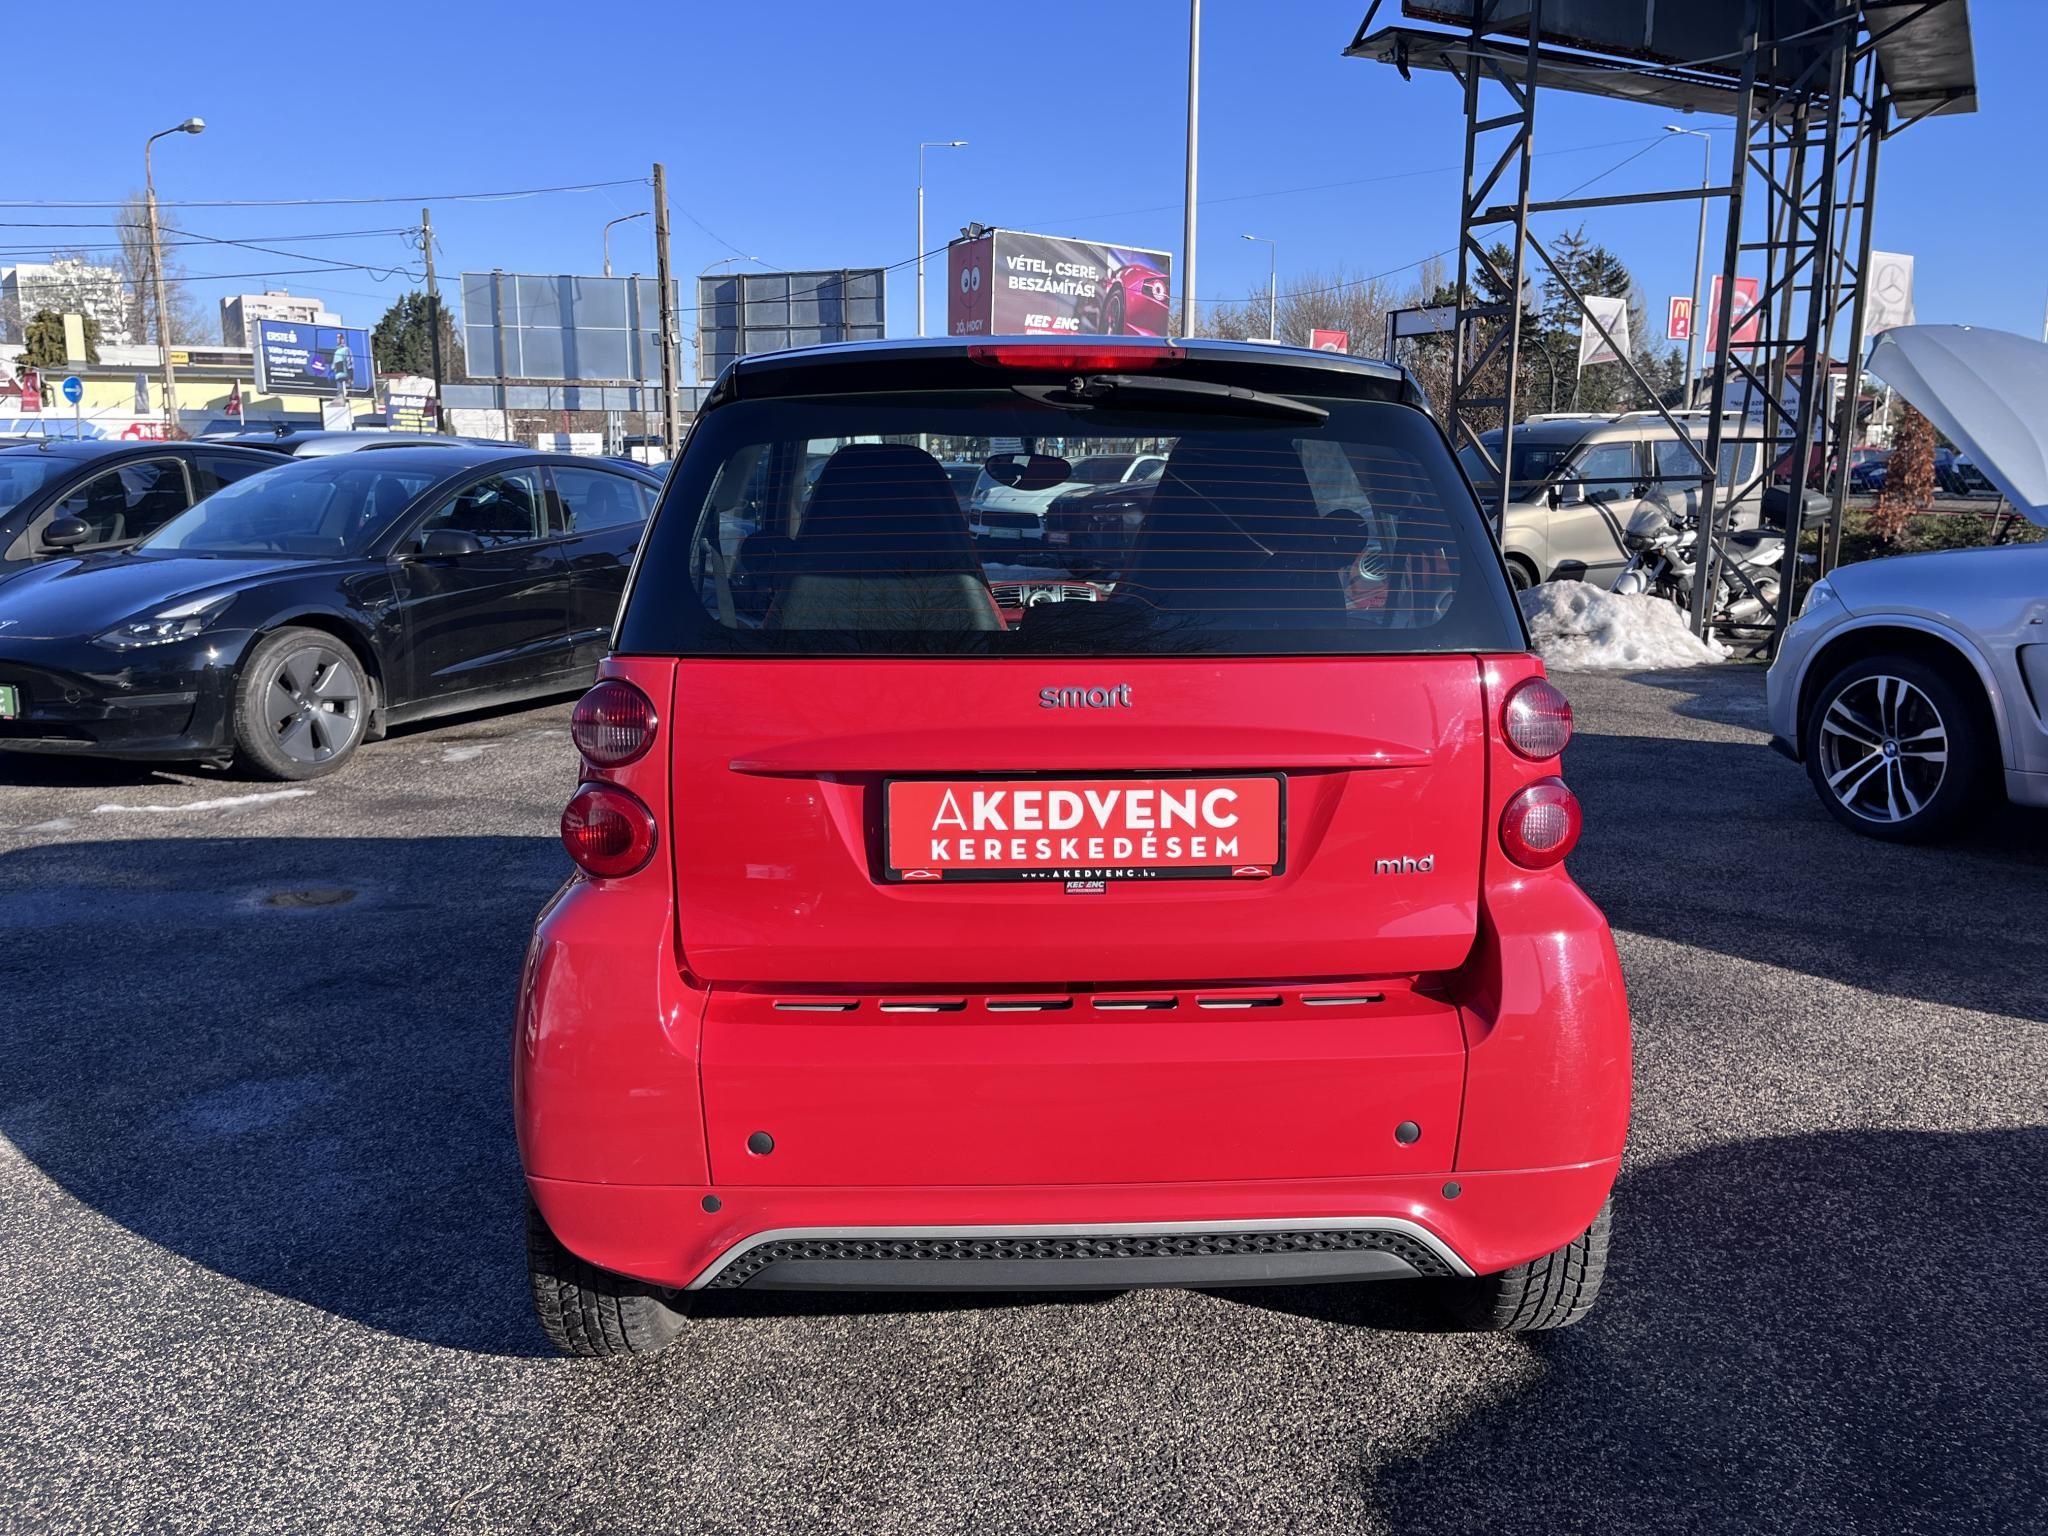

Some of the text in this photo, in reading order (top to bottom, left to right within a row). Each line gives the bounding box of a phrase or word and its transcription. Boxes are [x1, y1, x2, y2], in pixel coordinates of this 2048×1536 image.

[1006, 254, 1100, 282] VÉTEL, CSERE,
[1008, 275, 1096, 298] BESZÁMÍTÁS!
[1038, 683, 1132, 708] smart
[930, 831, 1239, 861] KERESKEDÉSEM
[1021, 869, 1156, 878] www.AKEDVENC.hu
[1374, 854, 1434, 874] mhd
